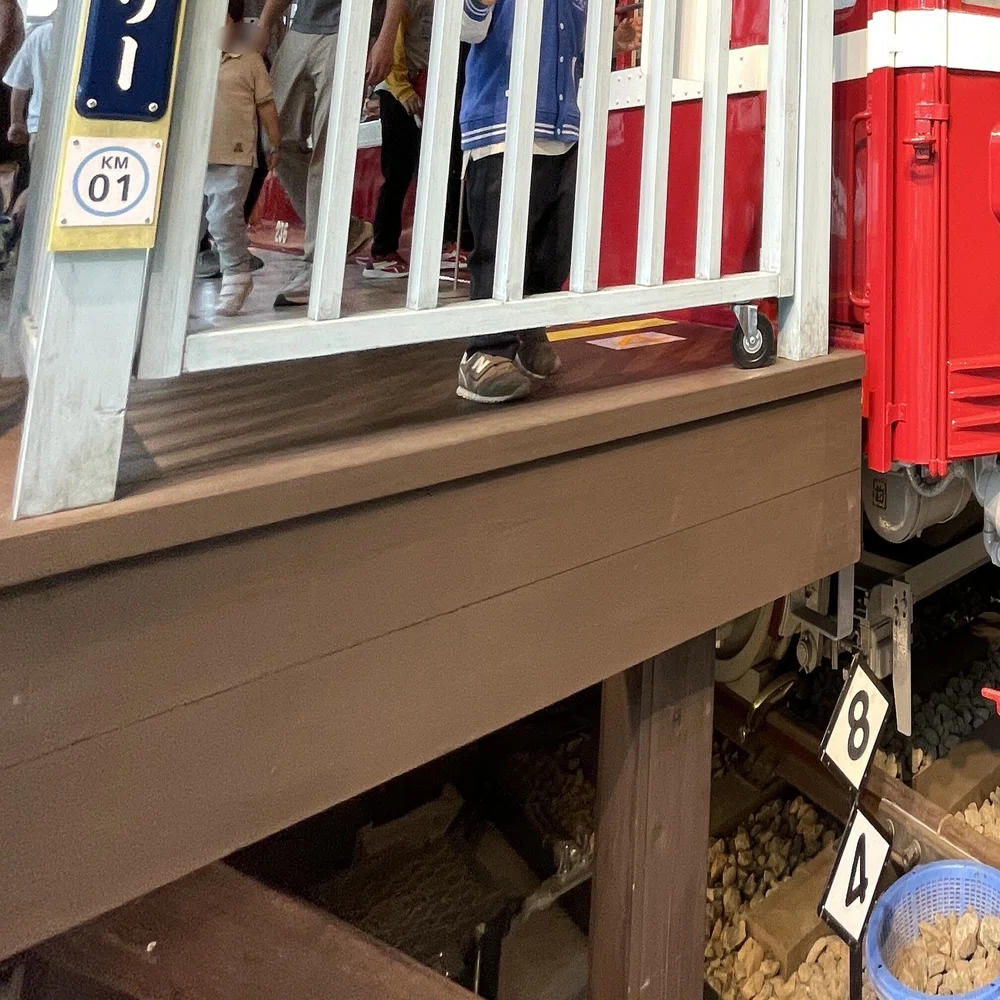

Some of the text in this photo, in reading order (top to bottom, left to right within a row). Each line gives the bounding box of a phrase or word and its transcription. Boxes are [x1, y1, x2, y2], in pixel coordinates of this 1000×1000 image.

[102, 156, 128, 169] KM
[88, 174, 131, 202] 01
[847, 690, 870, 761] 8
[845, 832, 868, 908] 4
